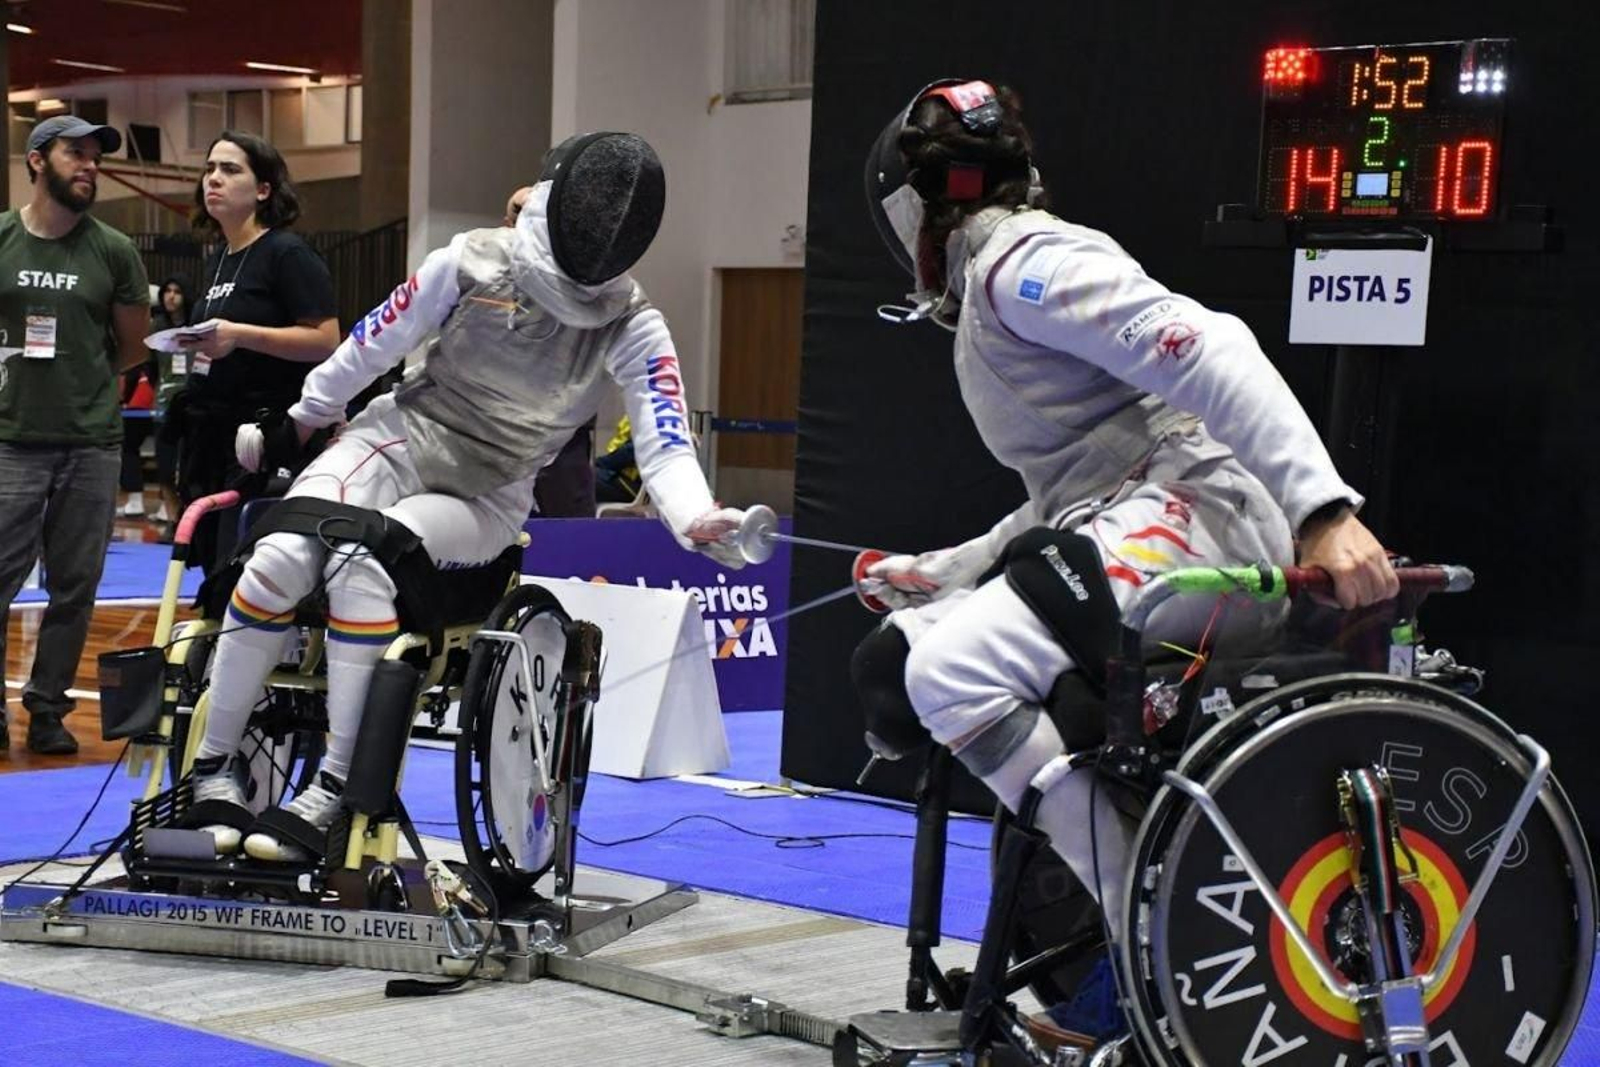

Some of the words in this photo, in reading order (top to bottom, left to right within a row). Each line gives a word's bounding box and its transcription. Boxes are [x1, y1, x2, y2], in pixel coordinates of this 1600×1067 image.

[1350, 54, 1430, 110] 1:52
[1363, 116, 1389, 167] 2
[1286, 147, 1339, 213] 14
[1434, 140, 1493, 215] 10
[17, 269, 79, 291] STAFF
[1307, 275, 1387, 303] PISTA
[1393, 277, 1412, 305] 5
[646, 355, 690, 449] KOREA
[1379, 741, 1530, 869] ESP
[84, 895, 160, 919] PALLAGI
[166, 901, 208, 923] 2015
[215, 905, 244, 925] WF
[251, 908, 314, 931] FRAME
[320, 913, 346, 934] TO
